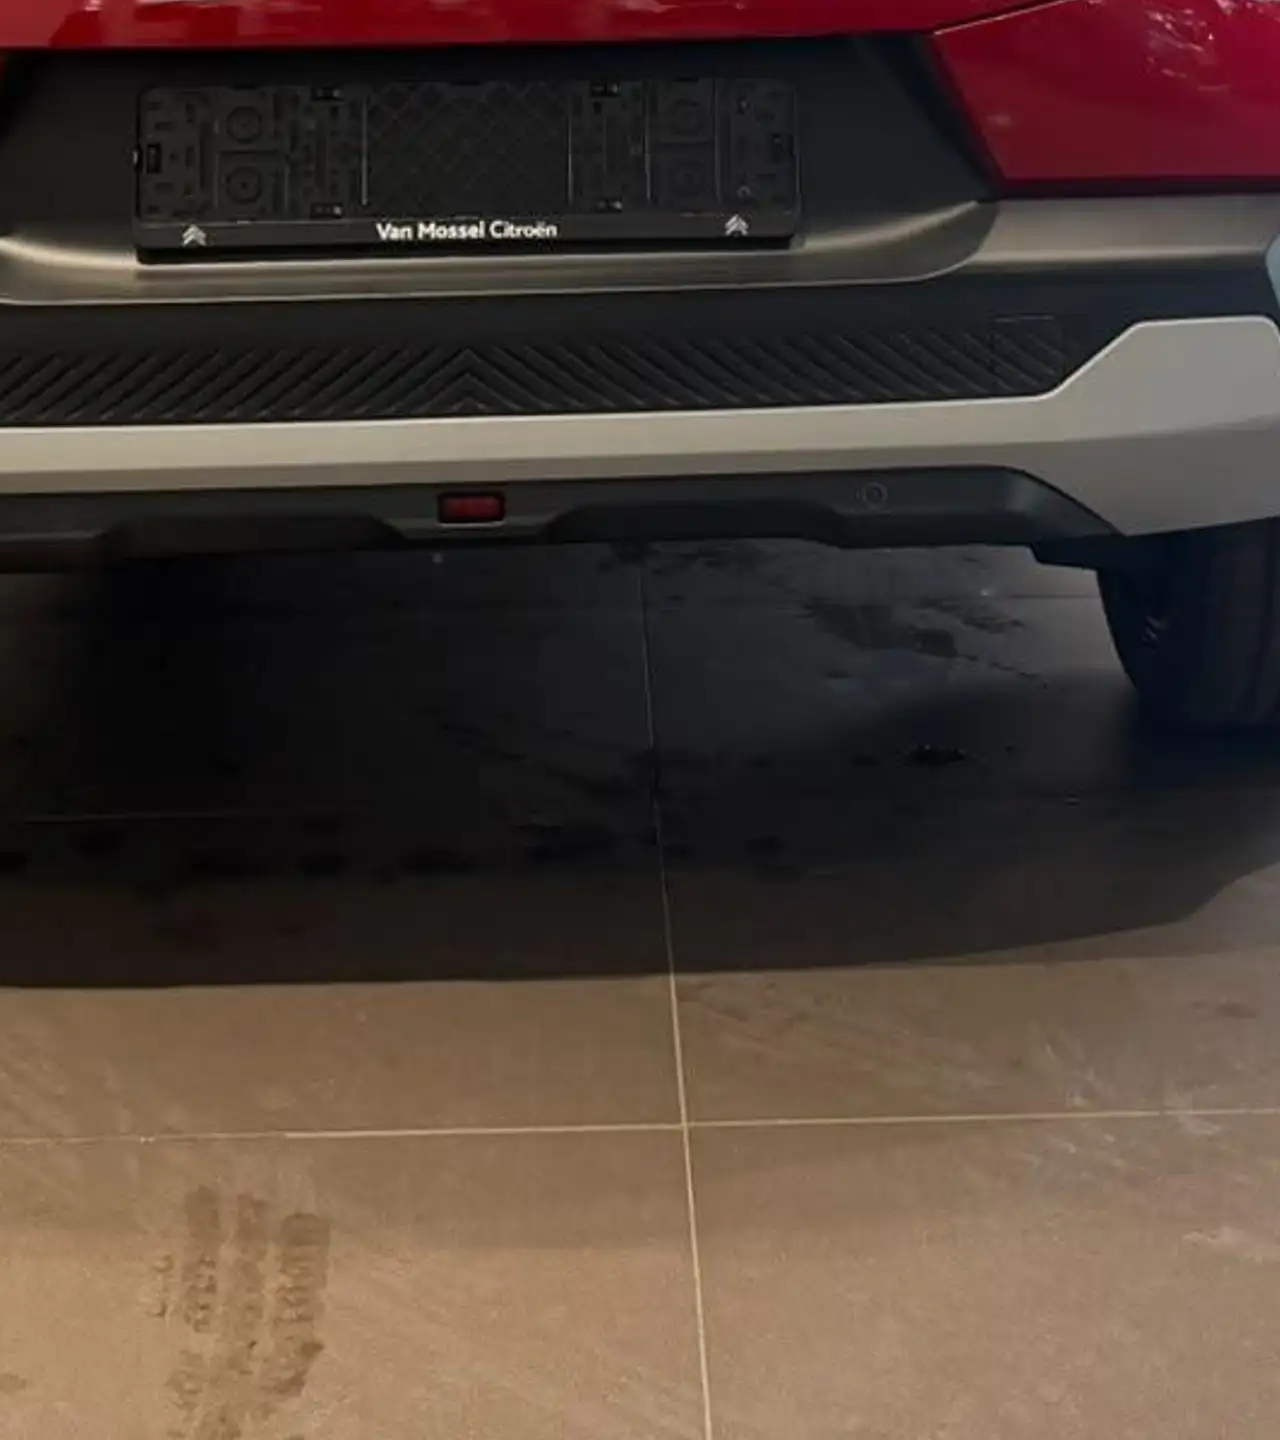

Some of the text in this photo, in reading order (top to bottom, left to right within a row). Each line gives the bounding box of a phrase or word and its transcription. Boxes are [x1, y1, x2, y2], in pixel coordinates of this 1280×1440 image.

[376, 220, 558, 241] Van Mossel Citroën
